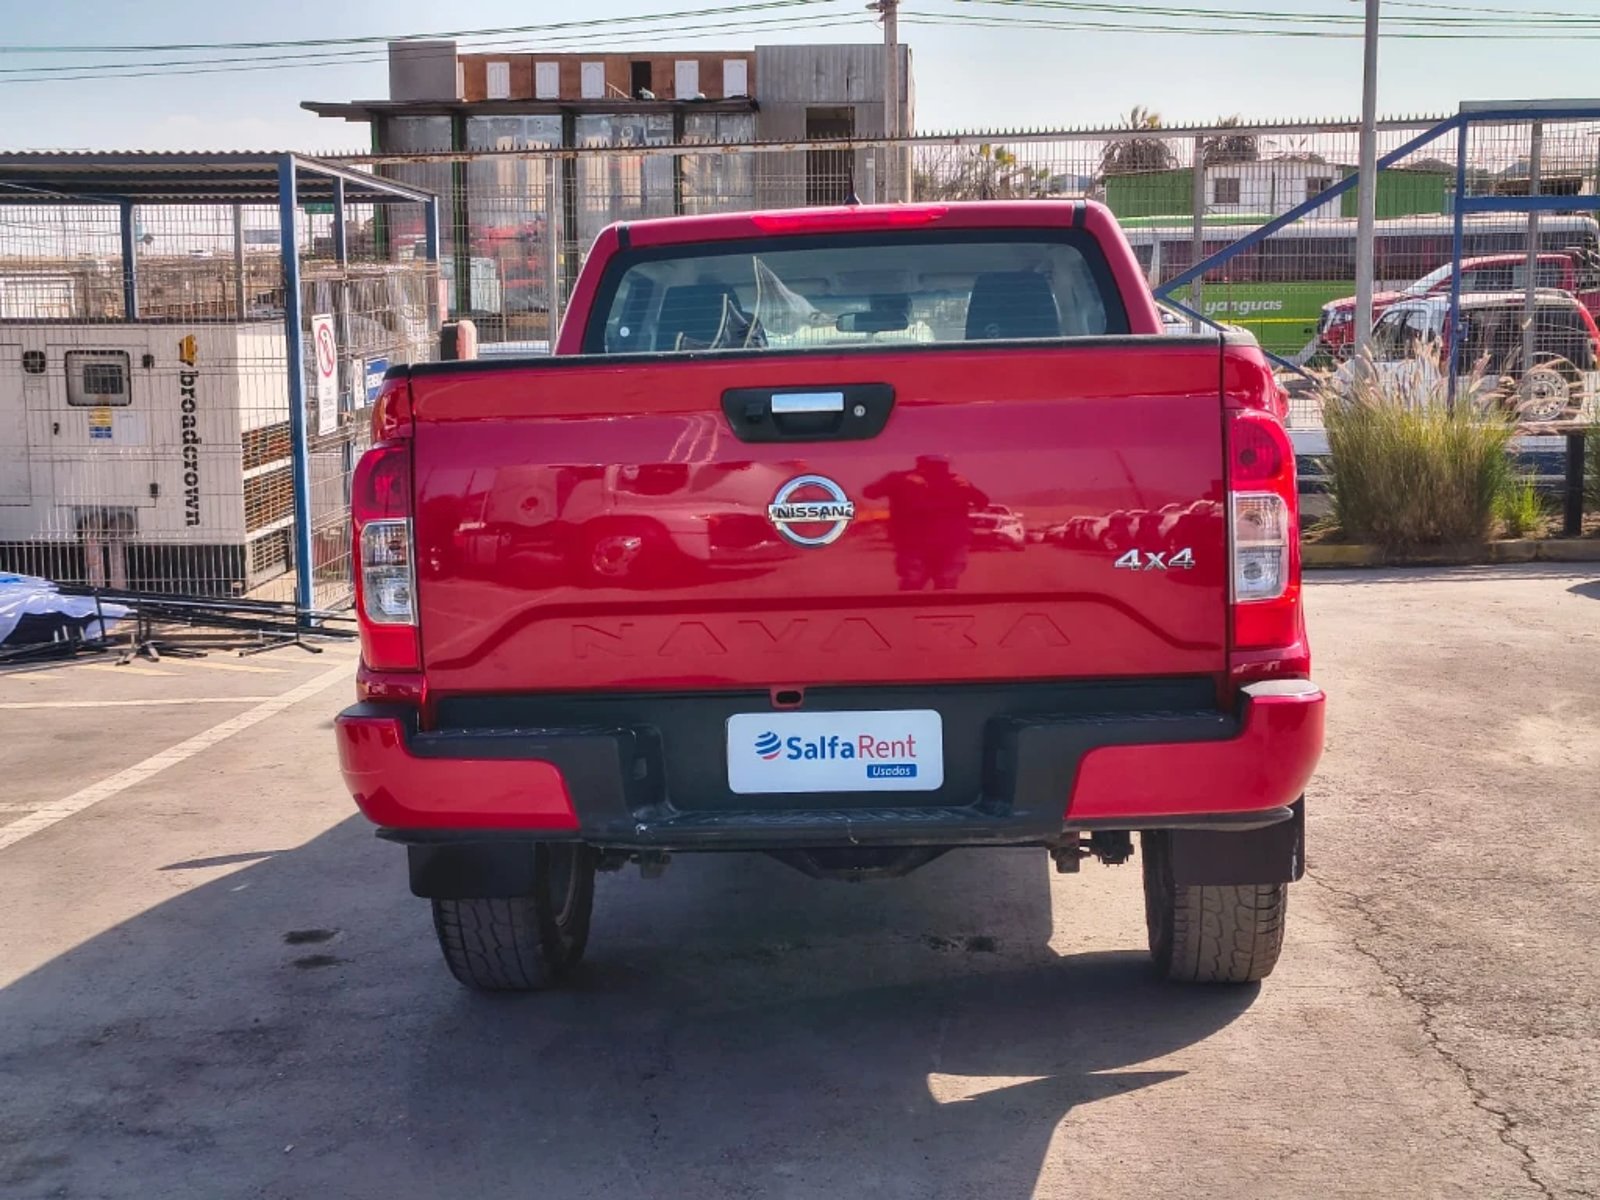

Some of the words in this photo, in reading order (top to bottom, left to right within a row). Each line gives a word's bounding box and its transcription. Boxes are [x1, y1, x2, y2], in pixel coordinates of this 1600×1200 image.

[180, 370, 202, 527] broadcrown
[776, 505, 846, 519] NISSAN
[1114, 547, 1196, 571] 4x4
[572, 612, 1073, 658] NAVARA
[872, 766, 911, 776] Usados
